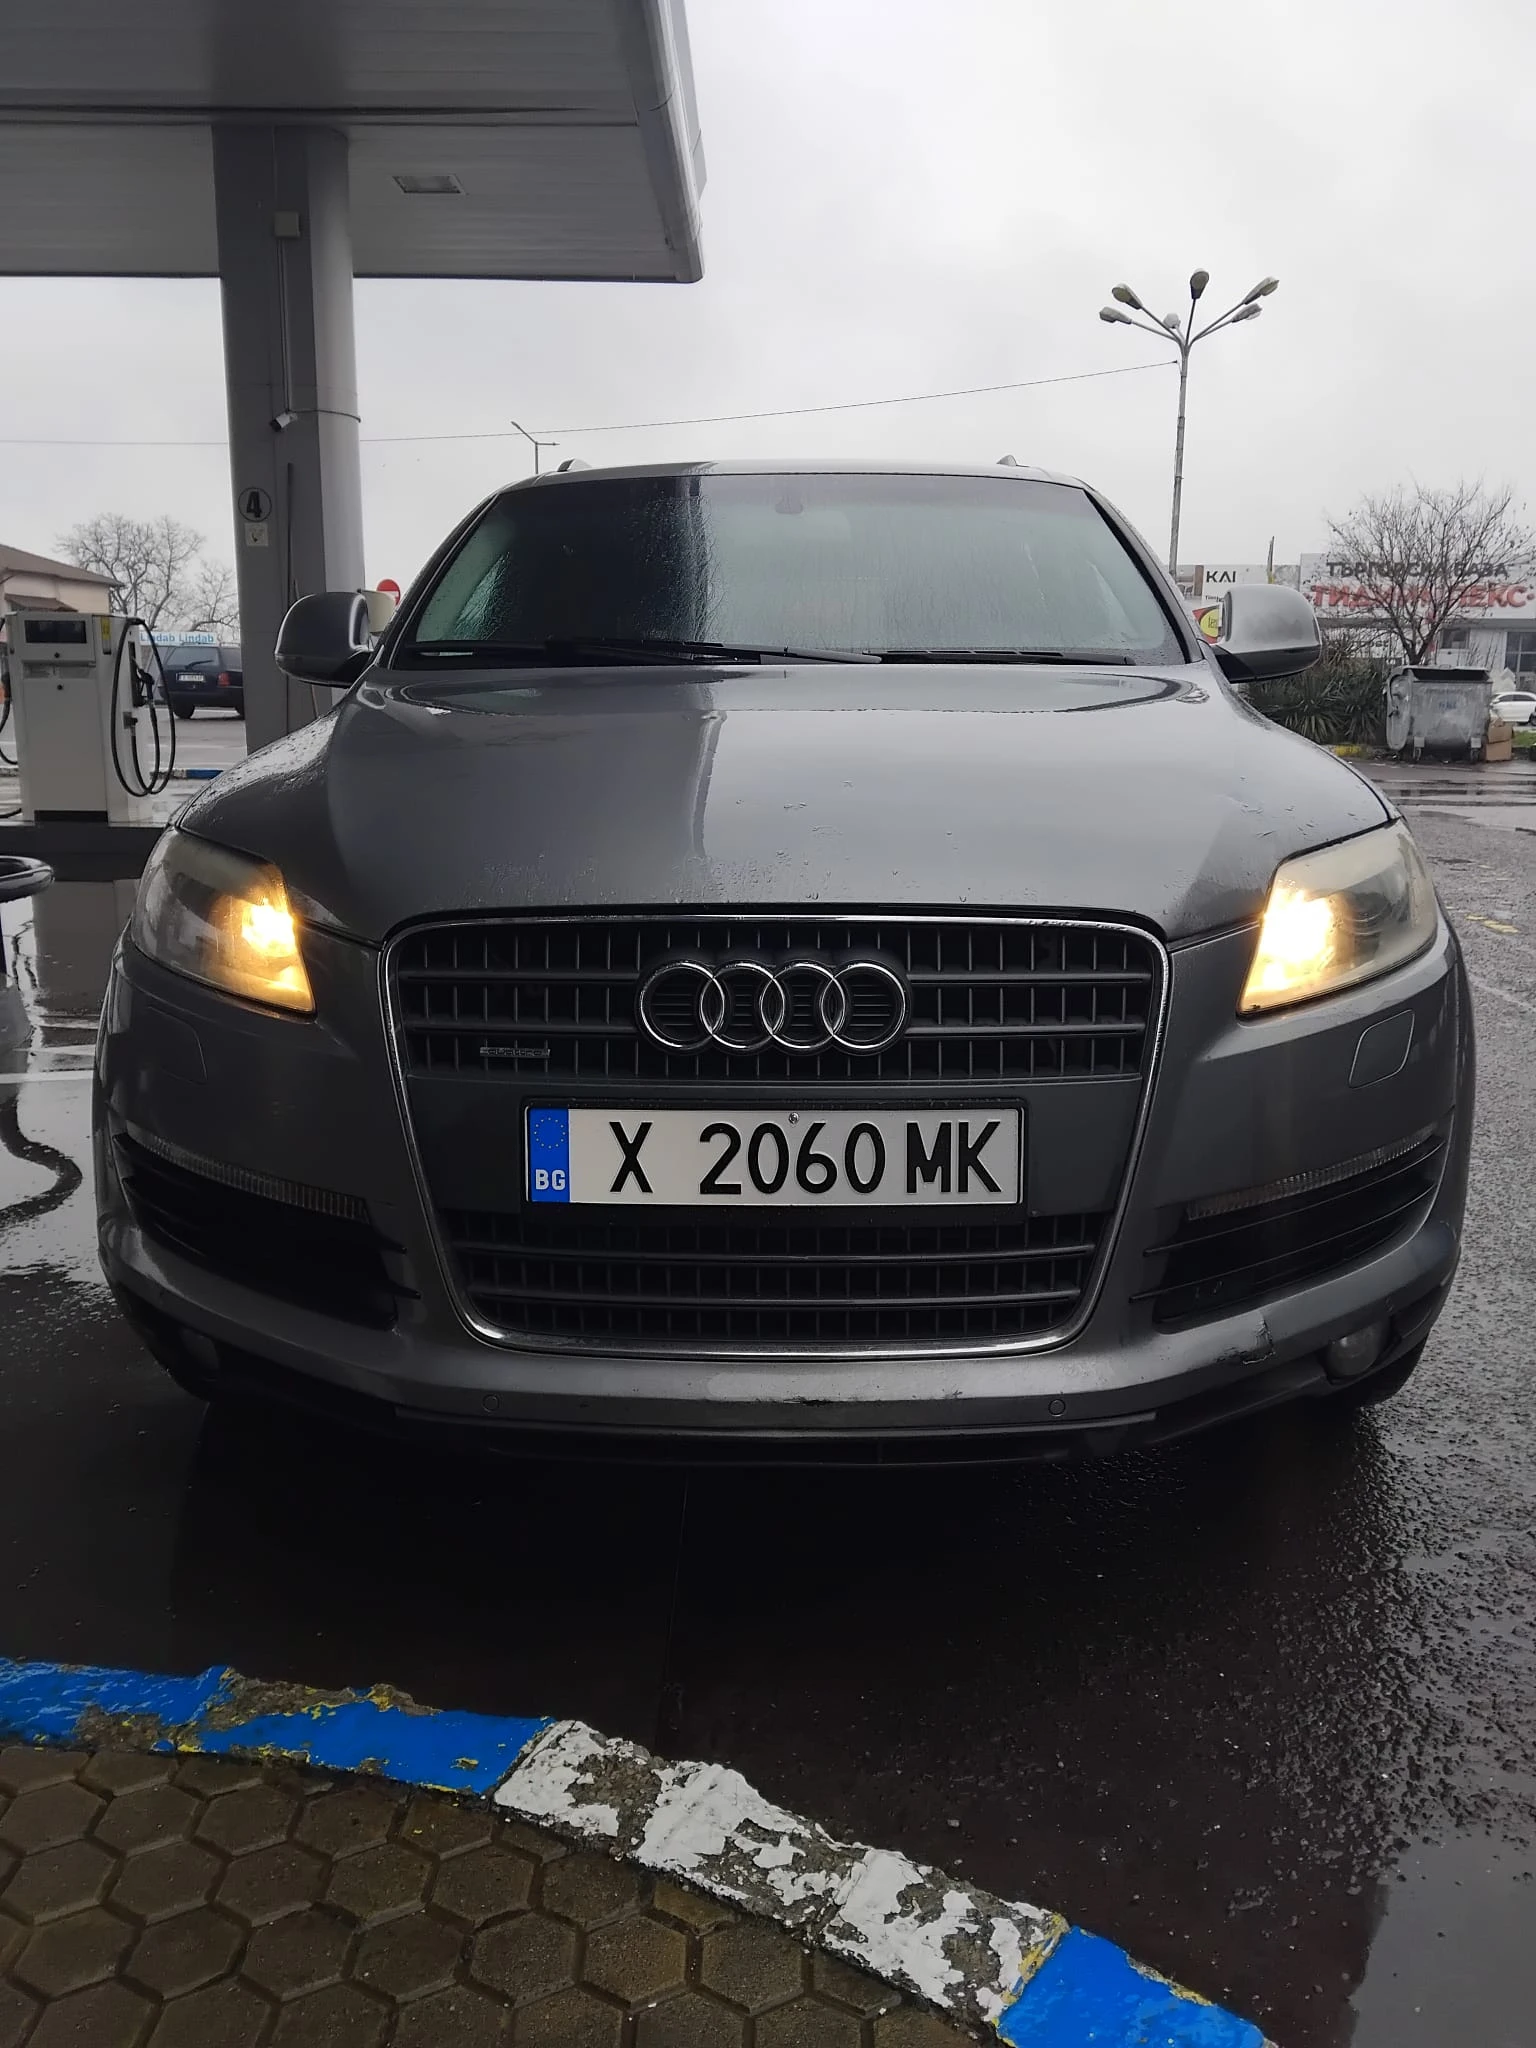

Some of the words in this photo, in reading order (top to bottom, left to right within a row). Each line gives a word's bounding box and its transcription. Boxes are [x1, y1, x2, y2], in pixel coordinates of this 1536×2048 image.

[246, 490, 262, 518] 4
[179, 633, 214, 643] Lindab
[698, 1122, 886, 1196] 2060
[906, 1121, 1001, 1194] MK
[534, 1169, 566, 1190] BG
